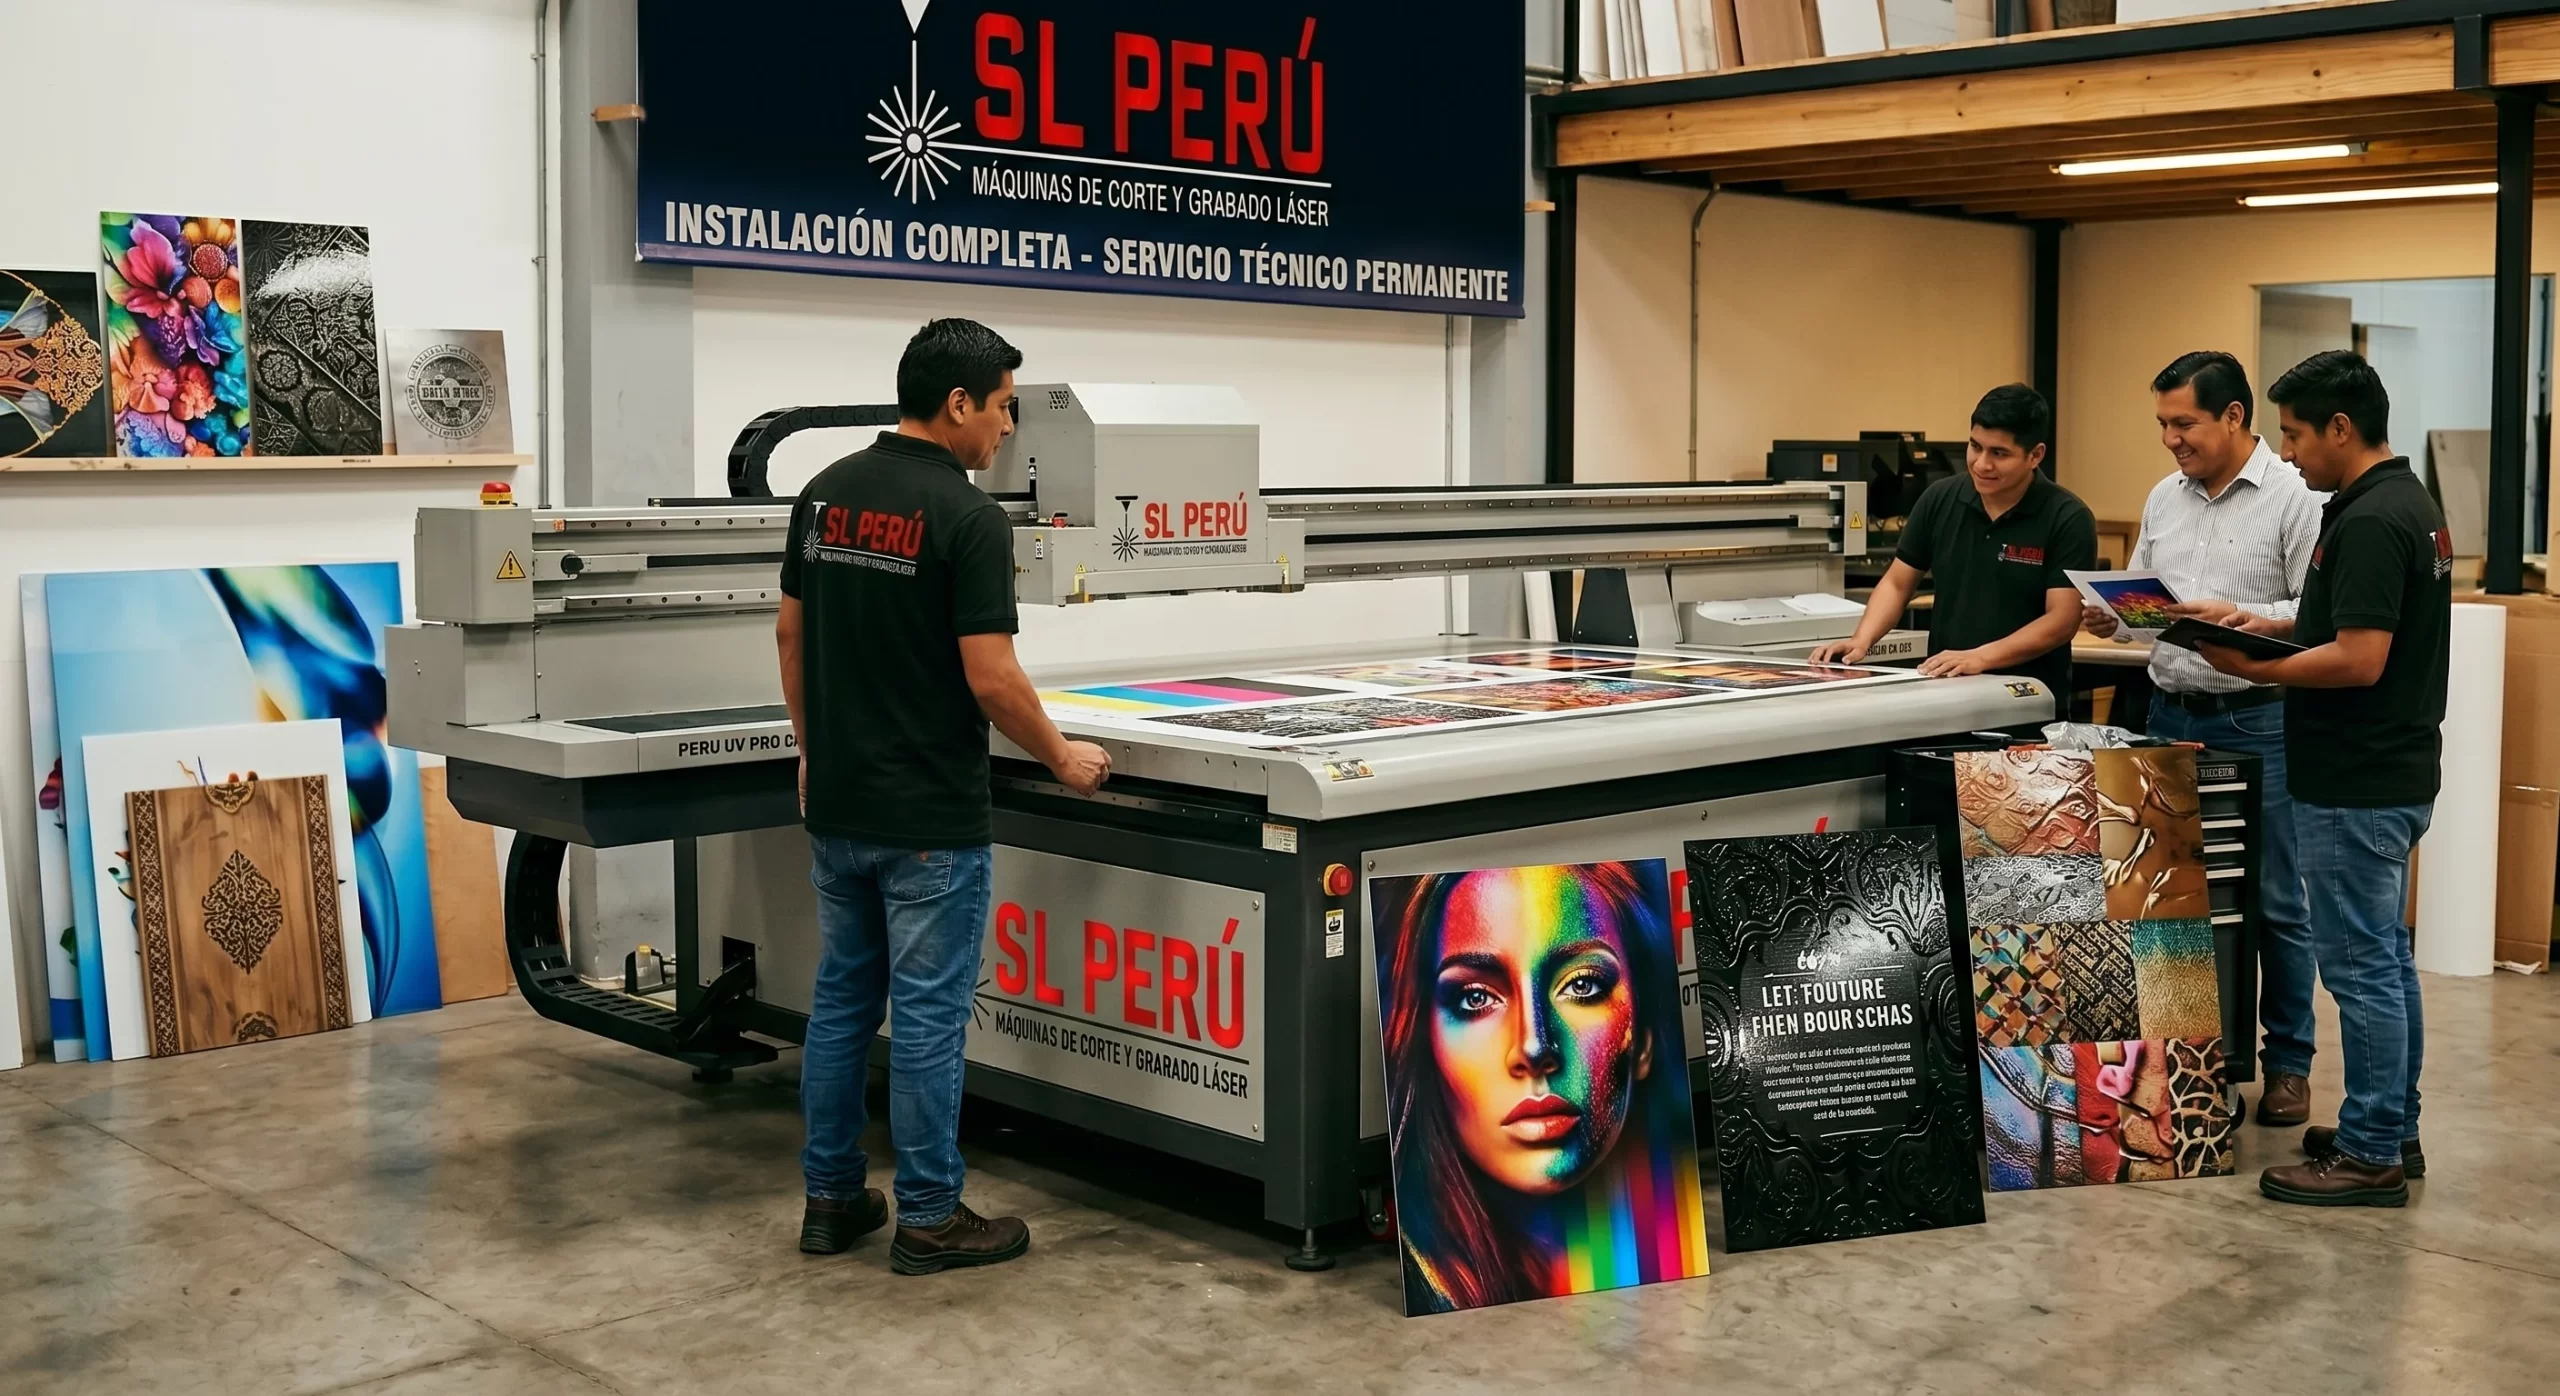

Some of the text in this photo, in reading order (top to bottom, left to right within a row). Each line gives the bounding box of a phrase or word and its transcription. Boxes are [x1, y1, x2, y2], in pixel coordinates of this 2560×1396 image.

[974, 11, 1324, 174] SL PERÚ
[972, 160, 1329, 227] MÁQUINAS DE CORTE Y GRABADO LÁSER
[665, 200, 1510, 303] INSTALACIÓN COMPLETA - SERVICIO TÉCNICO PERMANENTE
[823, 506, 924, 557] SL PERÚ
[1144, 492, 1247, 539] SL PERÚ
[678, 739, 720, 757] PERU
[724, 737, 746, 753] UV
[749, 734, 781, 751] PRO
[995, 902, 1245, 1050] SL PERÚ
[995, 1008, 1248, 1099] MÁQUINAS DE CORTE Y GRARADO LÁSER
[1751, 1003, 1914, 1038] FHEN BOUR SCHAS
